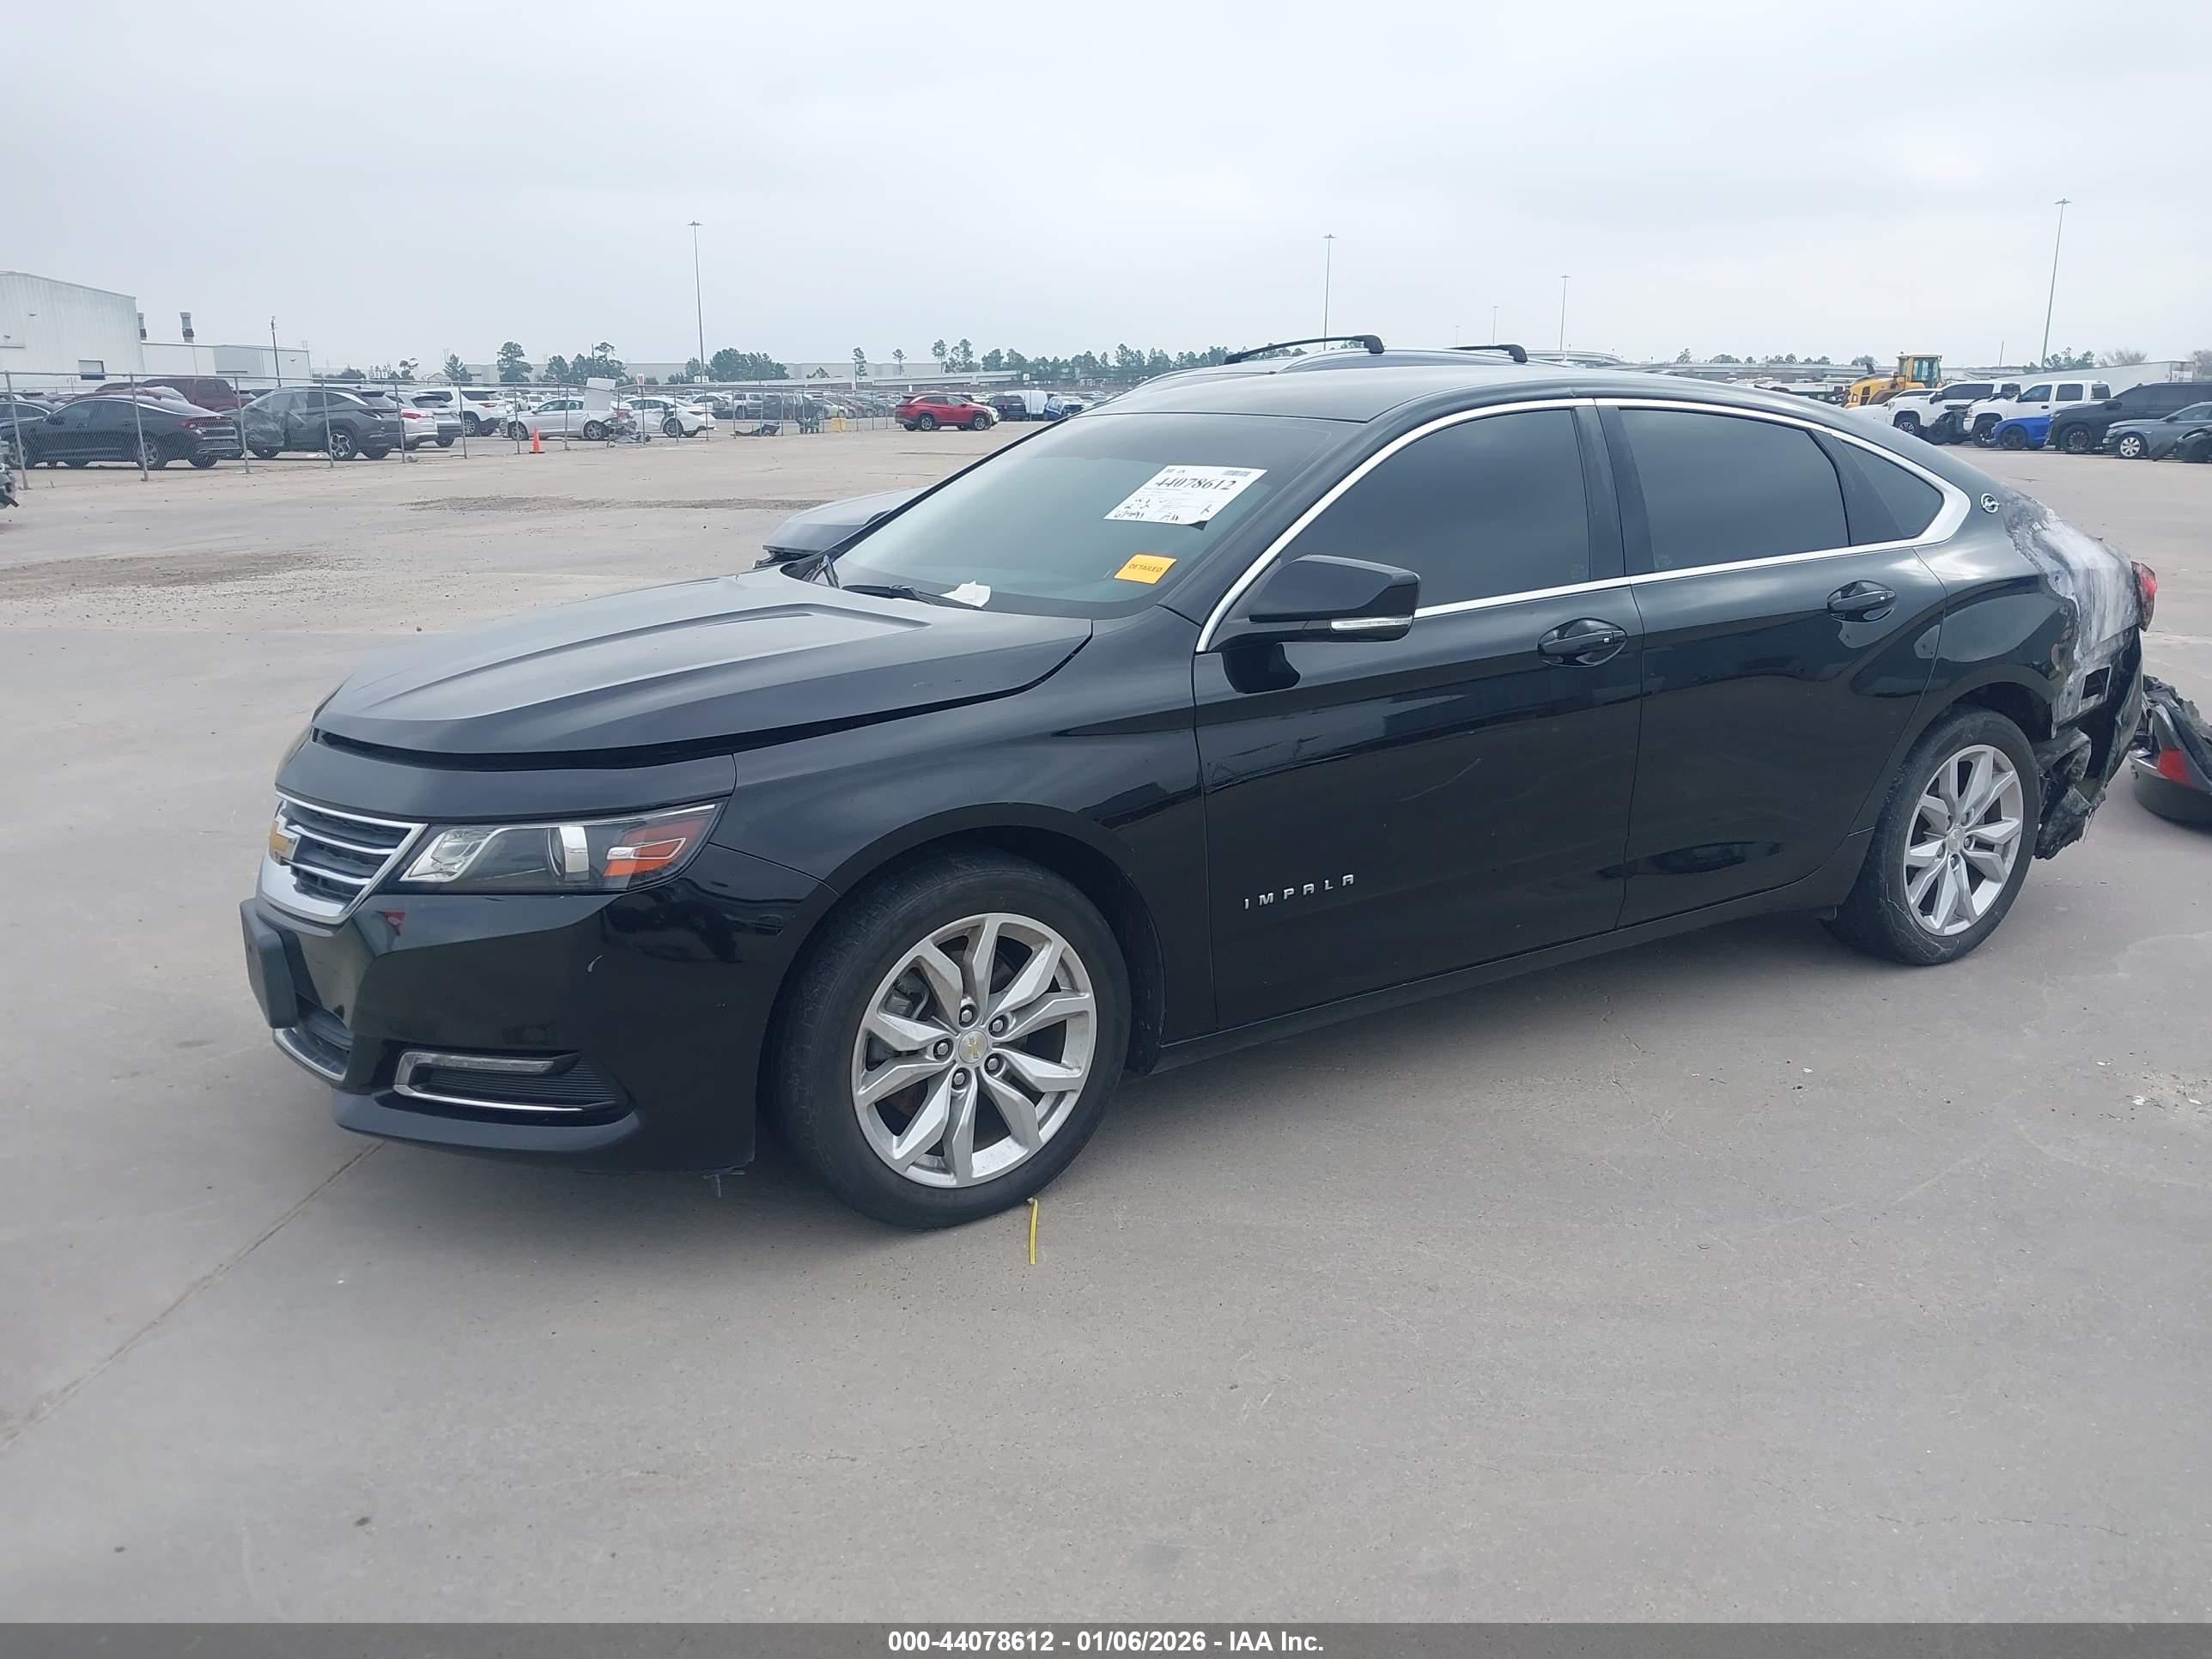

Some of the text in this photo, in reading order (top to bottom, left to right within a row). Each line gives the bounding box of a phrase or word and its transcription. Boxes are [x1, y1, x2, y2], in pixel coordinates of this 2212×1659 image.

[1156, 477, 1237, 490] 44078612
[1128, 563, 1164, 573] DETAILED
[1243, 873, 1354, 909] IMPALA
